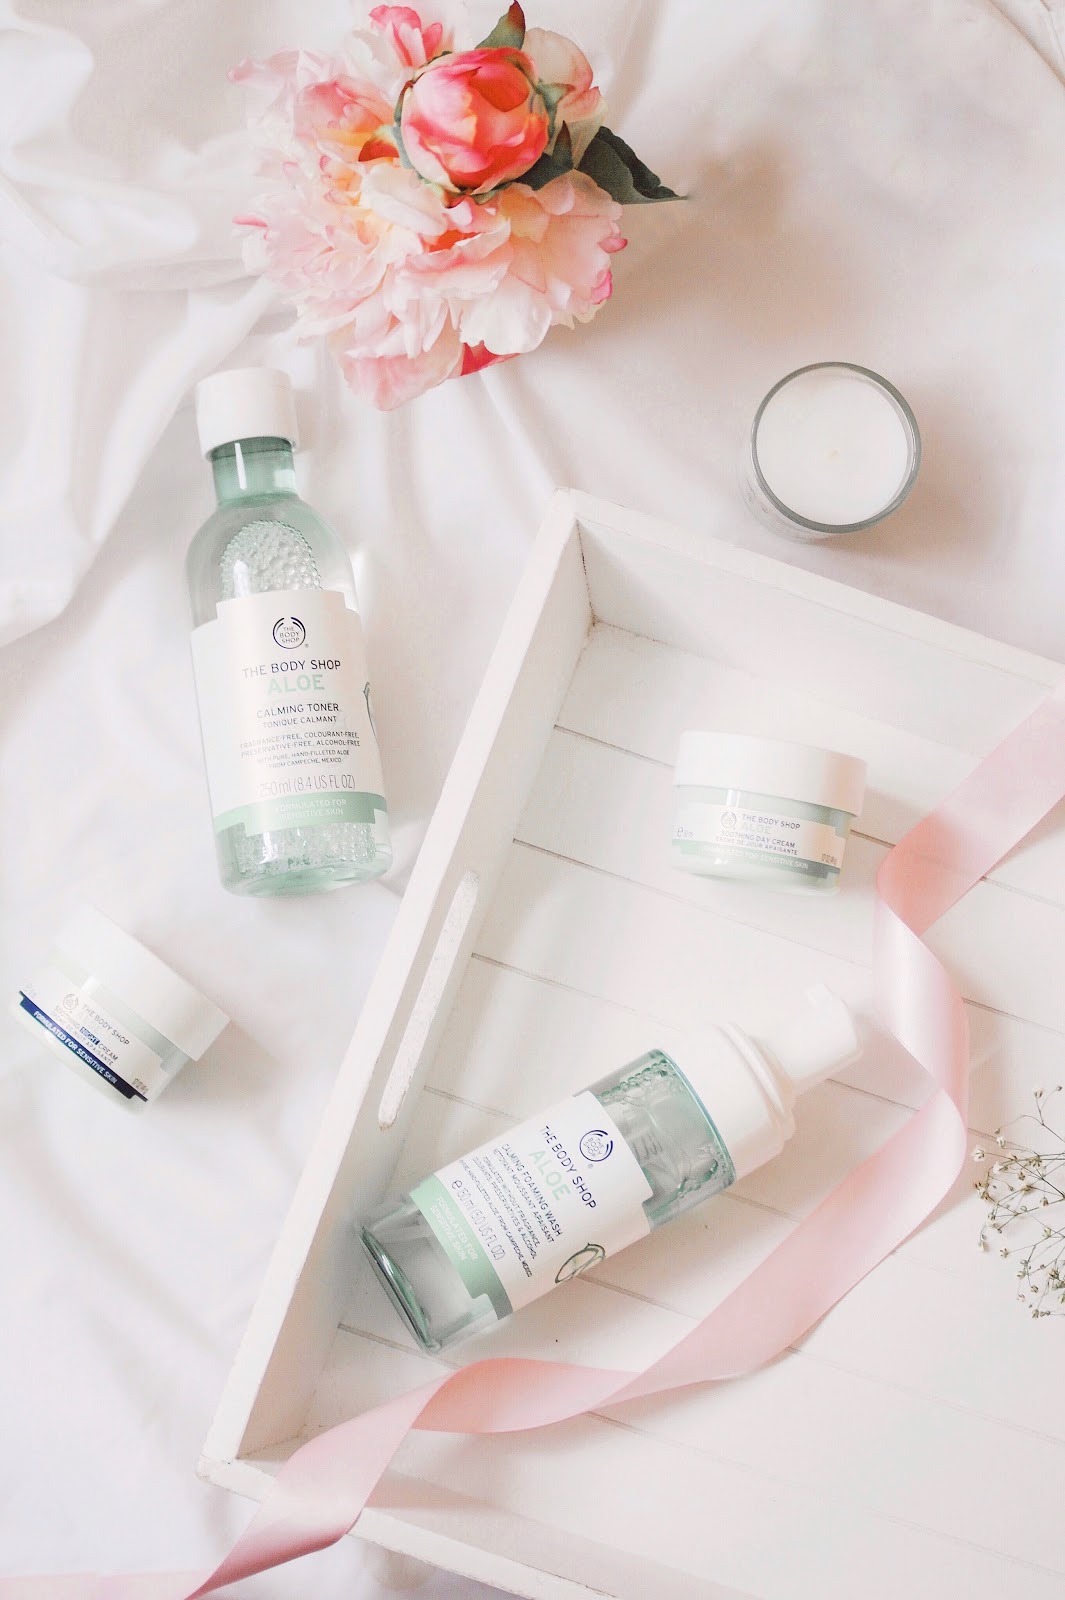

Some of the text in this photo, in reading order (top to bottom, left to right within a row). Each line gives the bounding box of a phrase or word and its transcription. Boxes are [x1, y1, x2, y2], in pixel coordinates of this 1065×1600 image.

[242, 659, 341, 679] THE BODY SHOP
[268, 674, 325, 695] ALOE
[256, 702, 339, 719] CALMING TONER
[263, 715, 337, 729] TONIQUE CALMANT
[269, 761, 286, 769] FROM
[314, 774, 328, 790] US
[329, 774, 340, 789] FL
[341, 774, 356, 790] OZ)
[275, 801, 331, 812] ORMULATED
[325, 807, 343, 816] SKIN
[741, 813, 757, 822] THE
[757, 816, 778, 826] BODY
[779, 820, 801, 831] SHOP
[720, 828, 796, 848] SOOTHING DAY CREAM
[745, 840, 763, 849] JOUR
[793, 861, 809, 869] SKIN
[80, 1003, 95, 1017] THE
[93, 1014, 112, 1032] BODY
[110, 1028, 130, 1047] SHOP
[64, 1037, 78, 1050] FOR
[75, 1047, 105, 1073] SENSITIVE
[102, 1070, 117, 1084] SKIN
[97, 1042, 118, 1061] CREAM
[587, 1137, 603, 1155] BODY
[529, 1146, 570, 1201] ALOE
[539, 1125, 597, 1209] THE BODY SHOP
[502, 1142, 563, 1236] CALMING FOAMING WASH
[511, 1174, 535, 1210] MOUSSANT
[532, 1210, 554, 1243] APAISANT
[490, 1181, 520, 1226] PRESERVATIVES
[519, 1232, 538, 1258] ALCOHOL
[452, 1240, 466, 1260] SKIN
[464, 1243, 478, 1260] FOR
